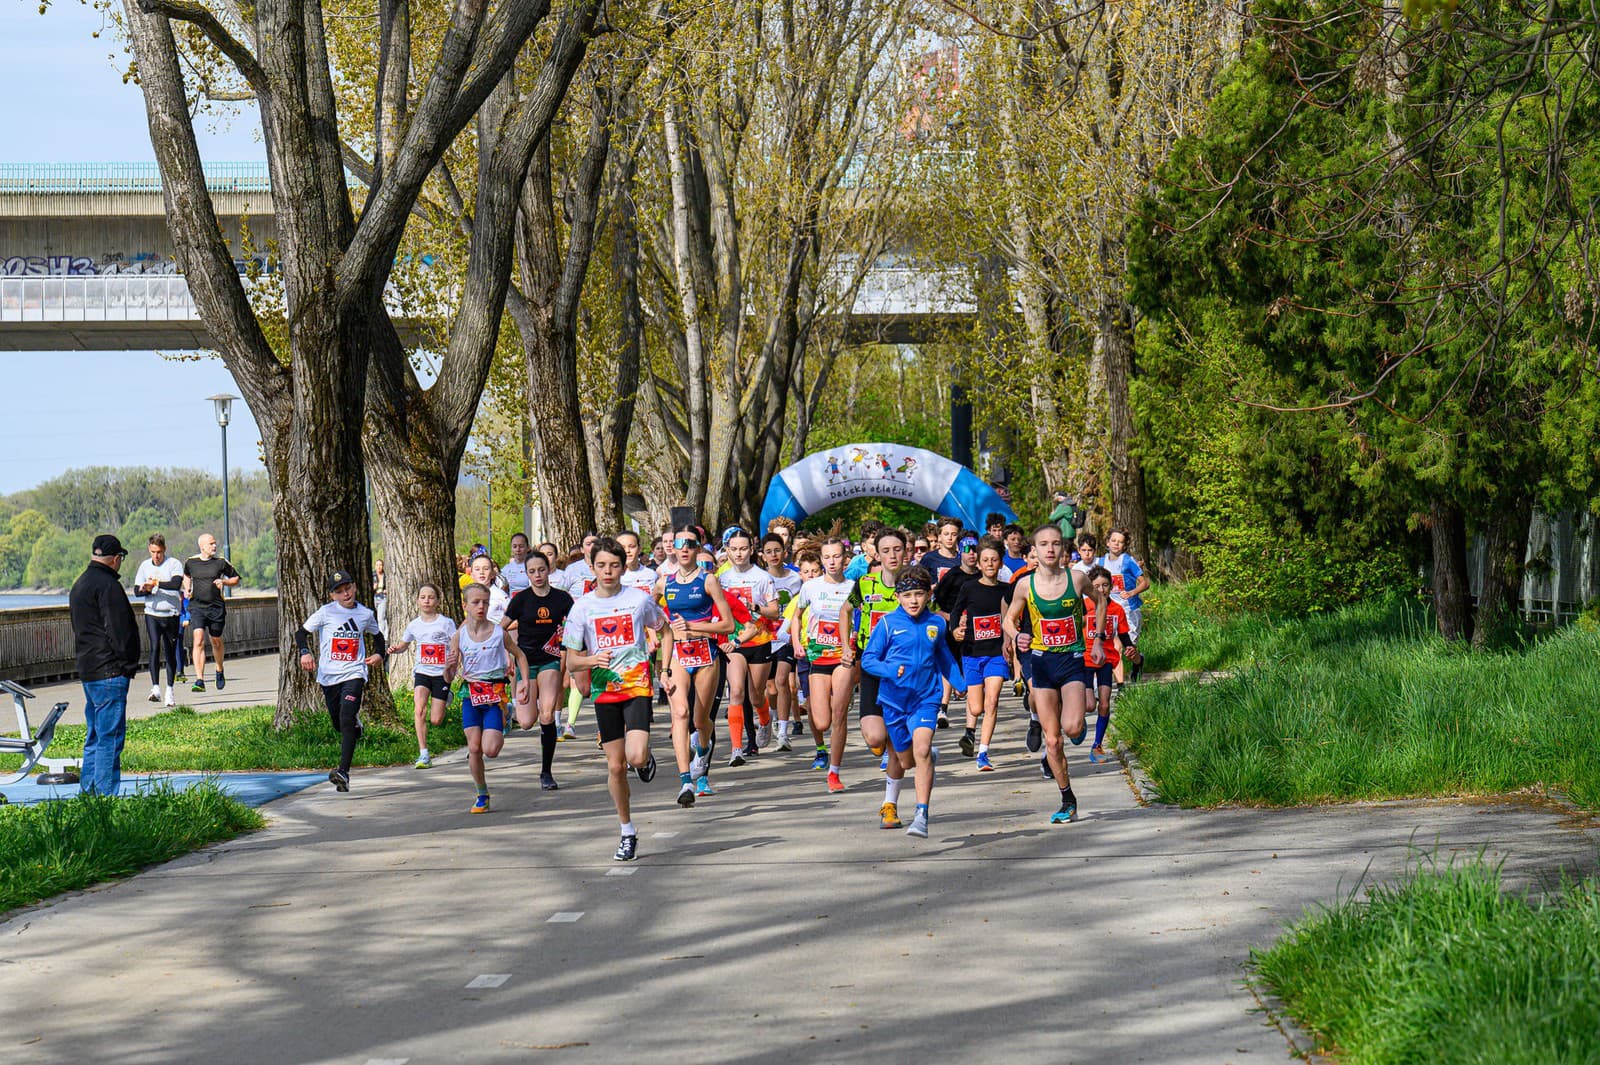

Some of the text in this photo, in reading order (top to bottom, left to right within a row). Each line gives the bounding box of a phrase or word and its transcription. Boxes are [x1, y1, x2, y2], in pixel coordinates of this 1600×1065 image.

[976, 629, 996, 638] 6095
[598, 635, 625, 647] 6014
[817, 634, 839, 645] 6088
[1043, 635, 1067, 646] 6137
[331, 651, 353, 661] 6376
[421, 656, 438, 664] 6241
[680, 656, 702, 666] 6253
[472, 694, 491, 704] 6132
